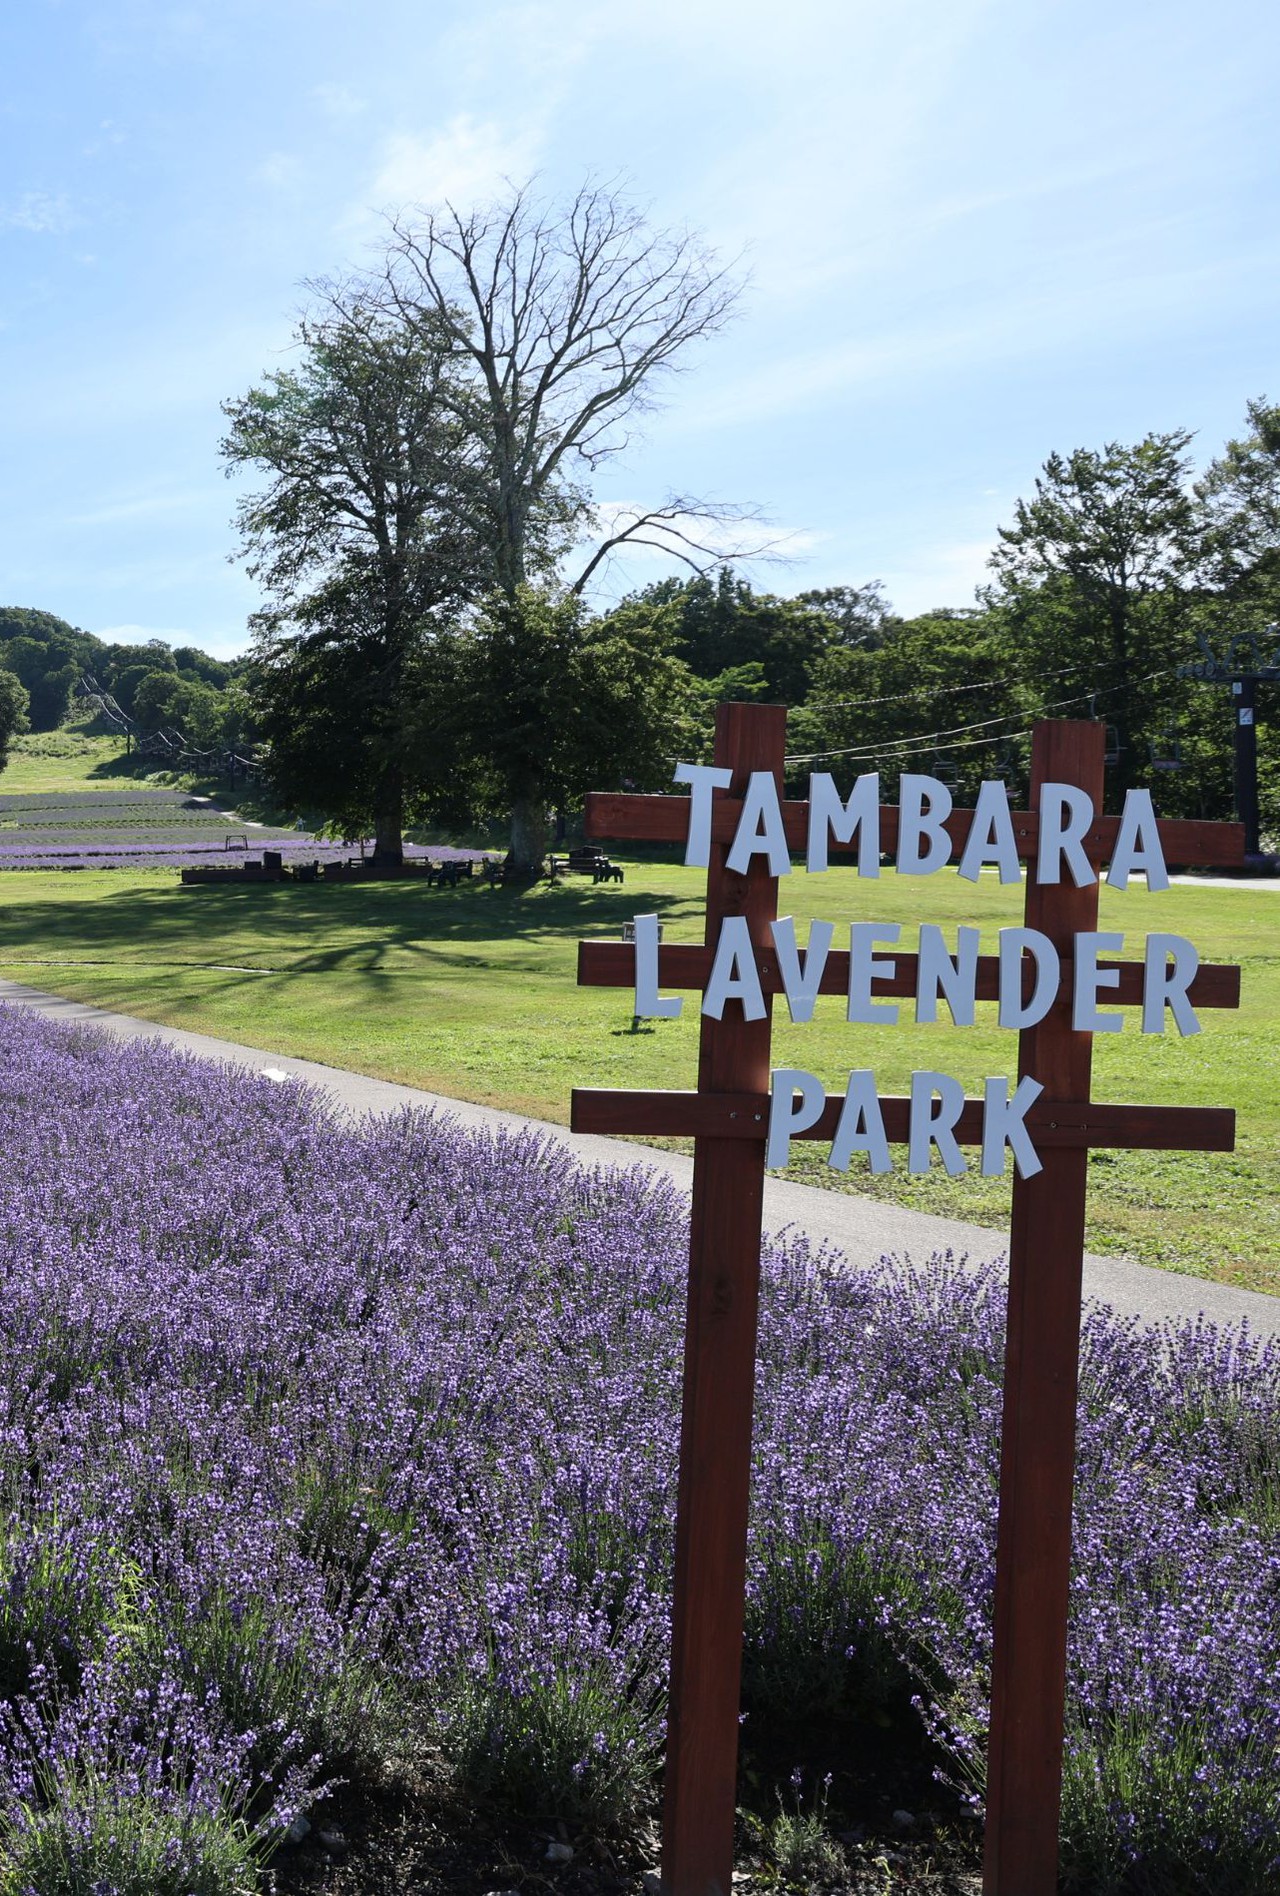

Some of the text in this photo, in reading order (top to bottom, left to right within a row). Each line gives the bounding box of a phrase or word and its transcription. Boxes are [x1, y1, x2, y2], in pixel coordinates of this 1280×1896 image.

[673, 763, 1170, 892] TAMBARA
[632, 913, 1201, 1036] LAVENDER
[765, 1068, 1045, 1180] PARK
